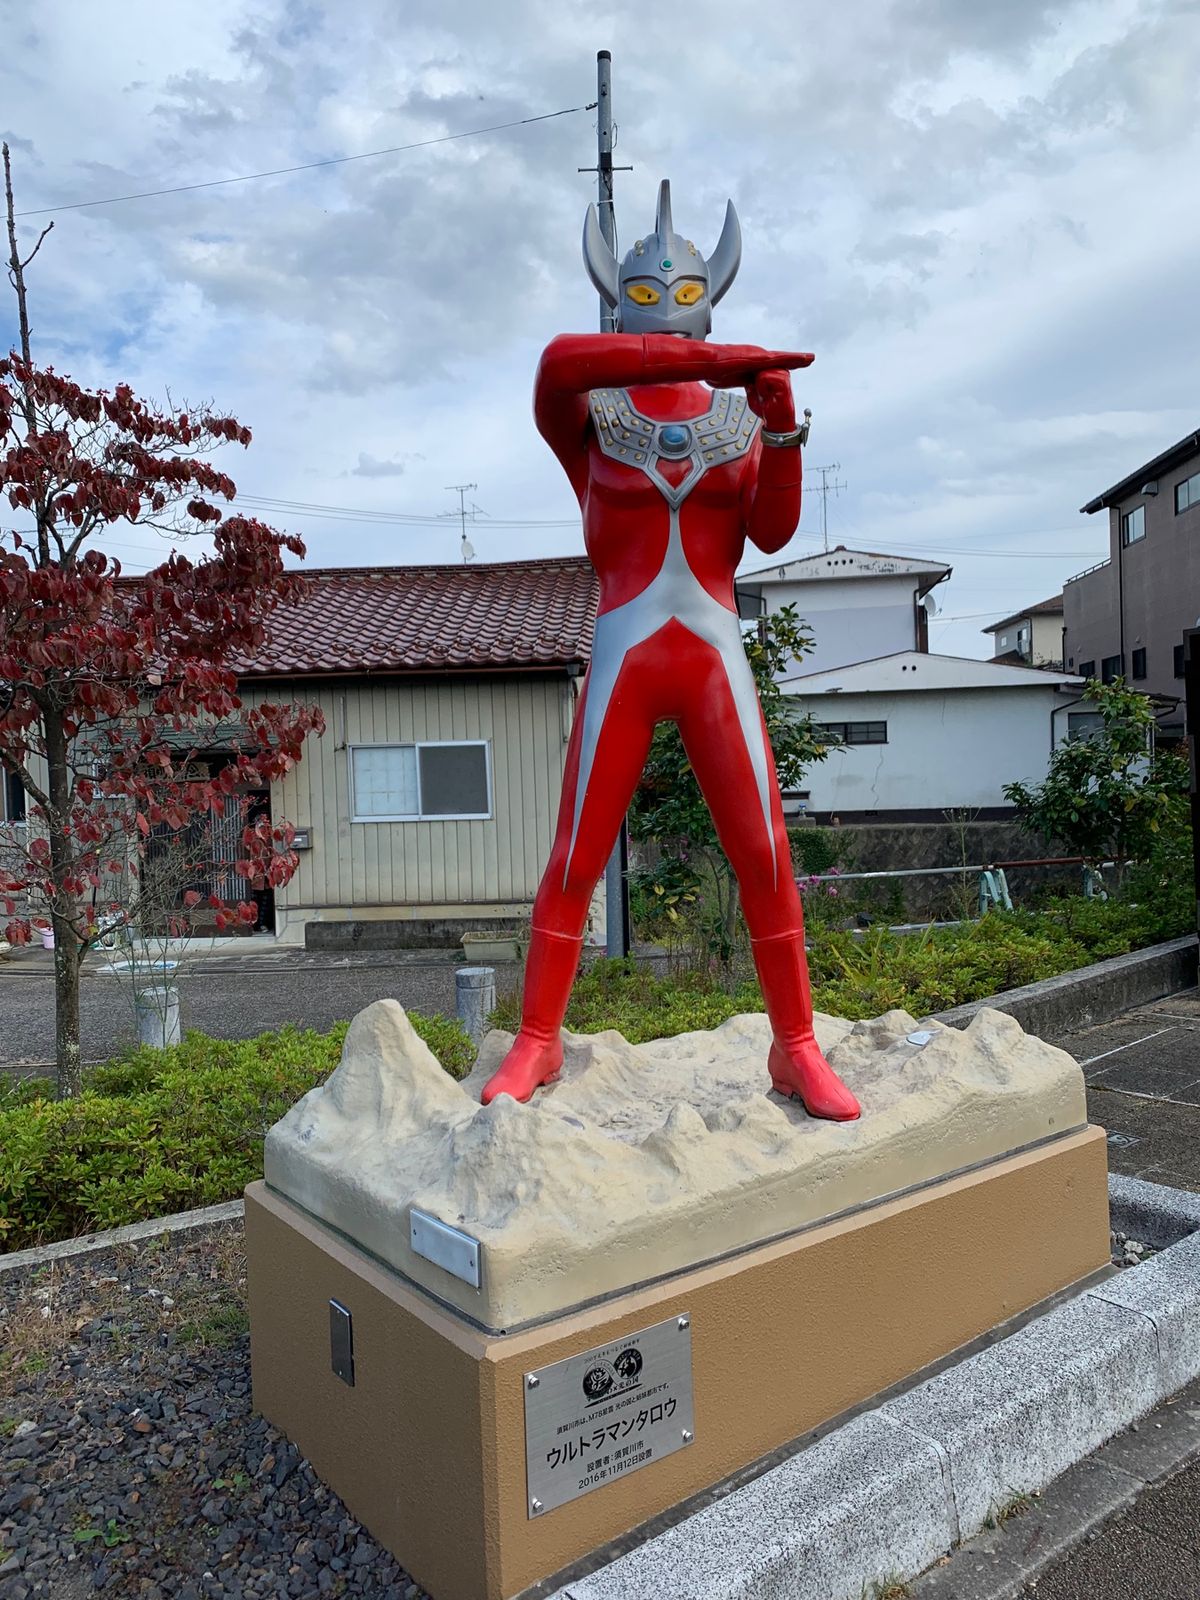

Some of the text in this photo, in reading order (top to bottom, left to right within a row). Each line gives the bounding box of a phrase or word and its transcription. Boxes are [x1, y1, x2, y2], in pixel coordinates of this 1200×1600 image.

[546, 1397, 677, 1469] ウルトラマンタロウ
[578, 1448, 653, 1489] 2016年11月12日設置
